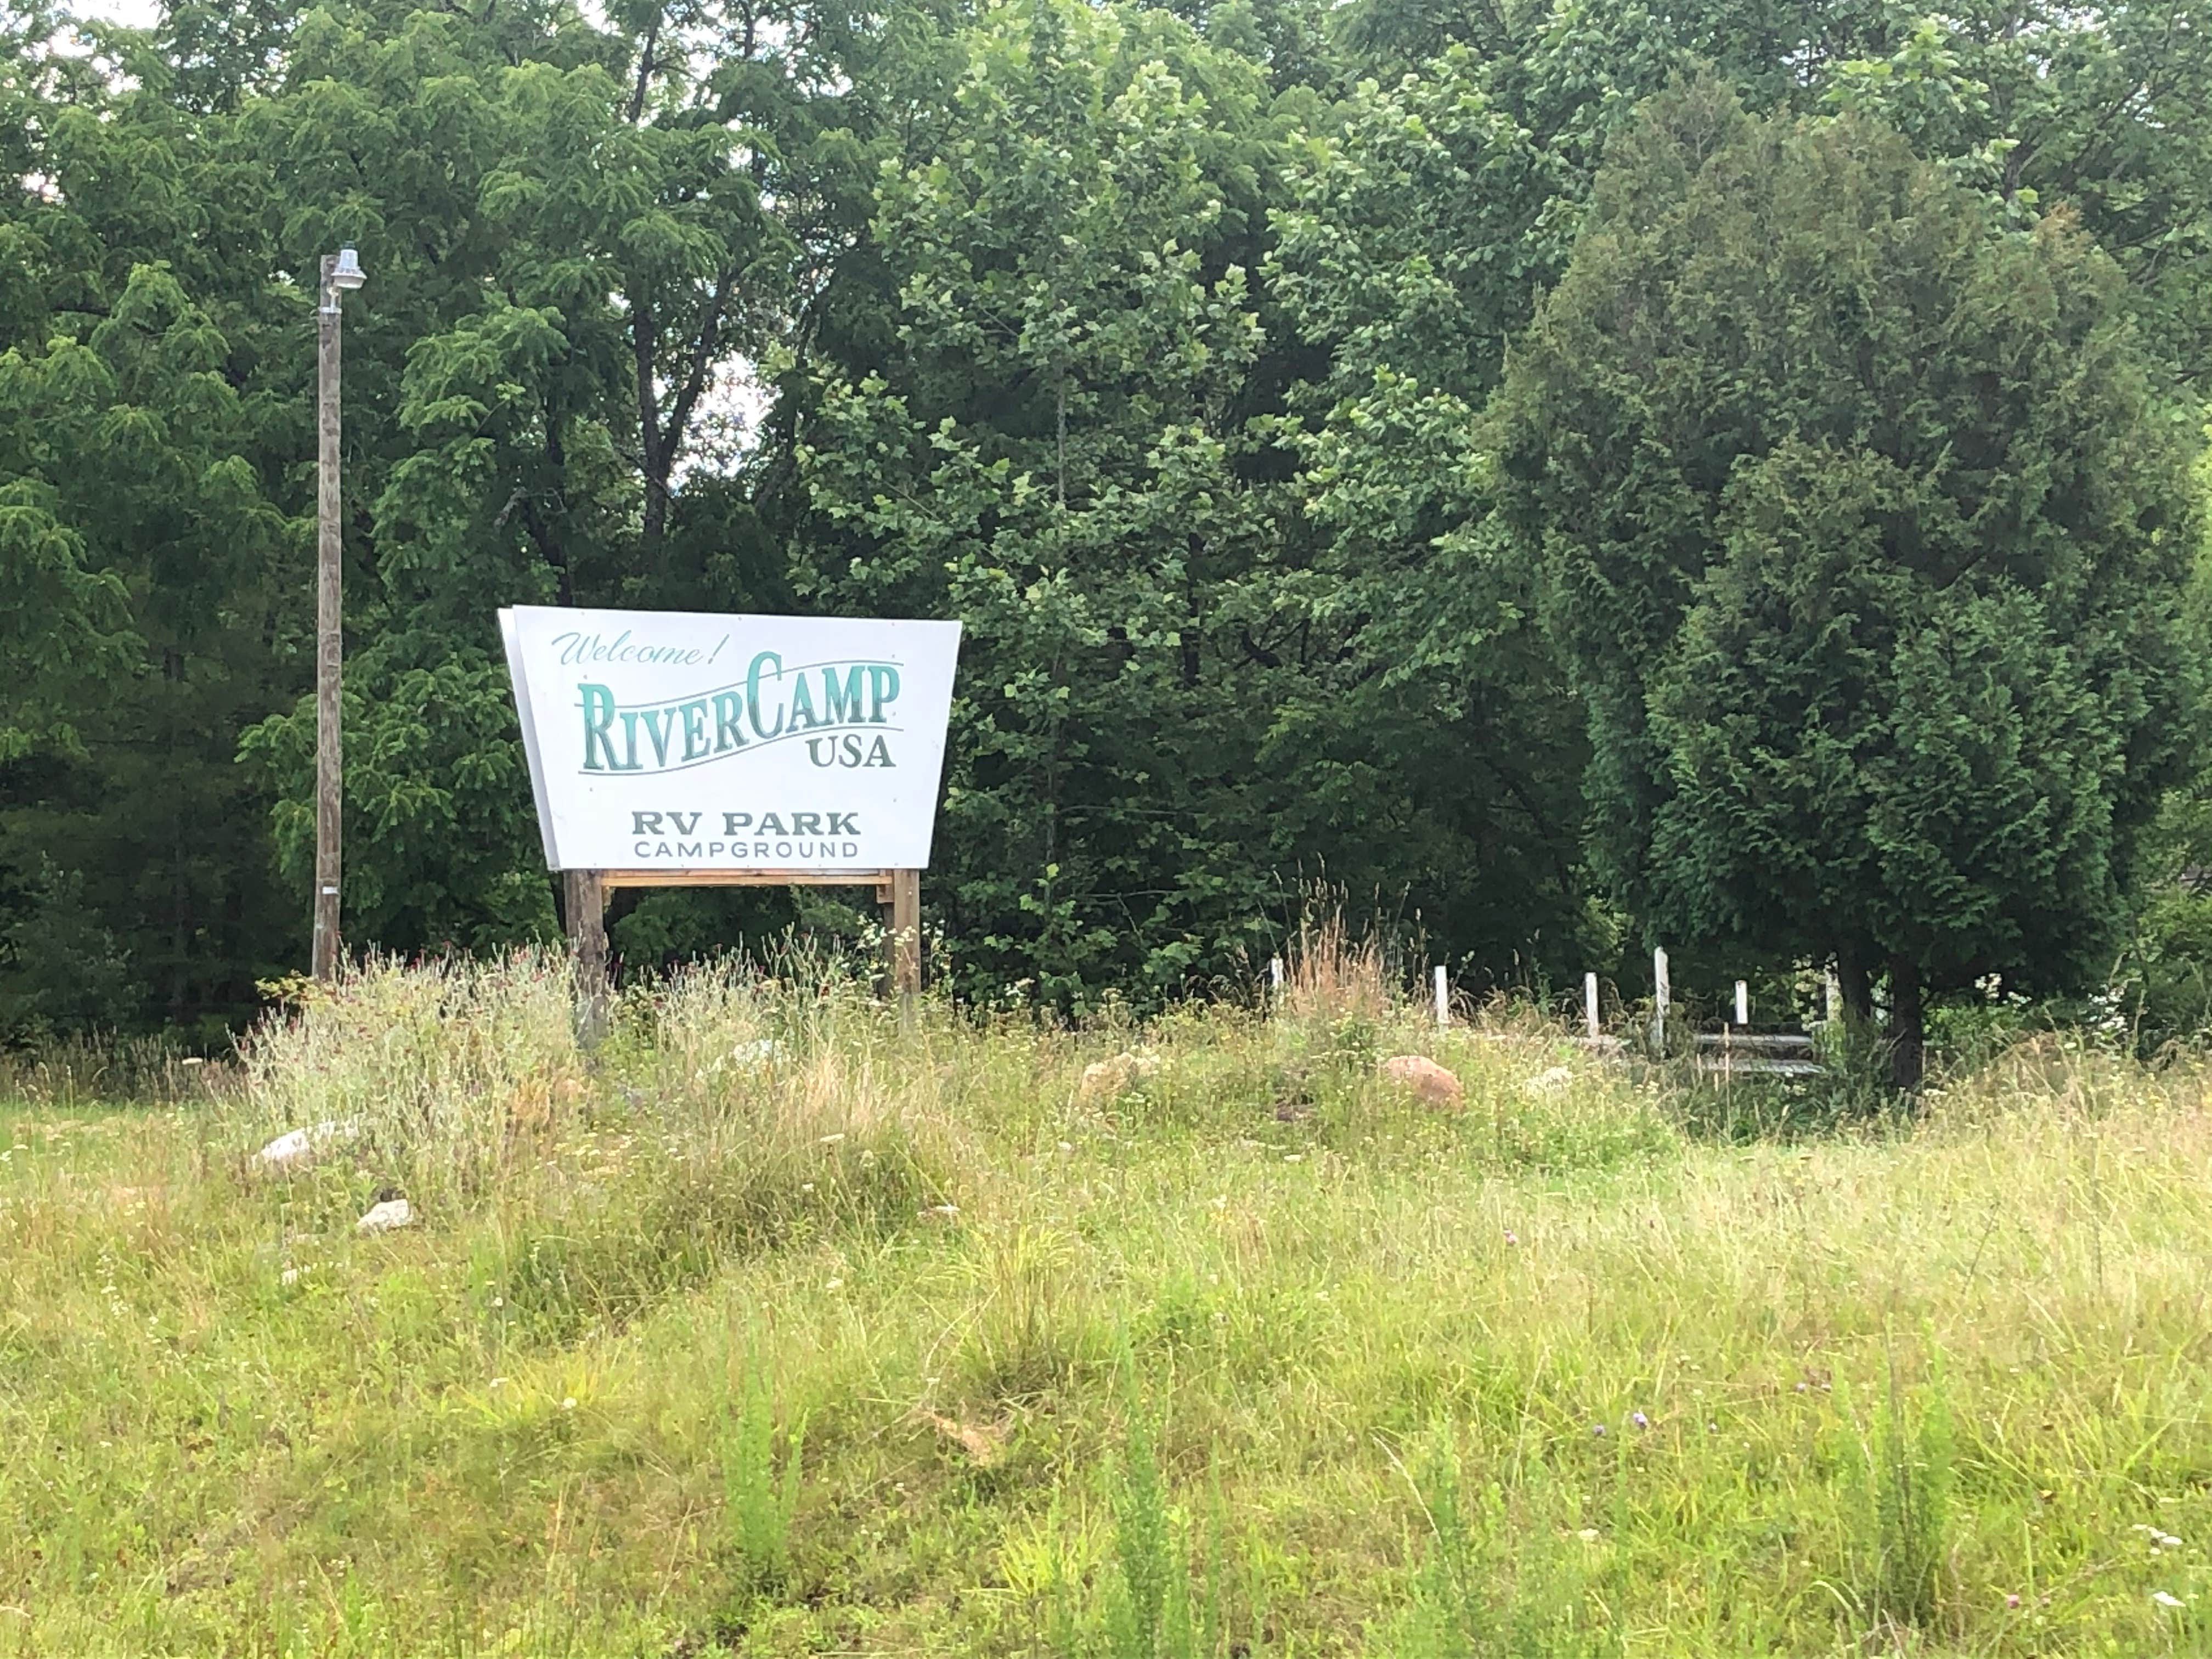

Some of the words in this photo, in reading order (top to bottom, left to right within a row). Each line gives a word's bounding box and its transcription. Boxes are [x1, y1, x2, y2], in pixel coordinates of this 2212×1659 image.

[551, 630, 730, 665] Welcome!
[806, 734, 897, 768] USA
[632, 811, 703, 836] RV
[722, 811, 861, 836] PARK
[634, 841, 859, 859] CAMPGROUND
